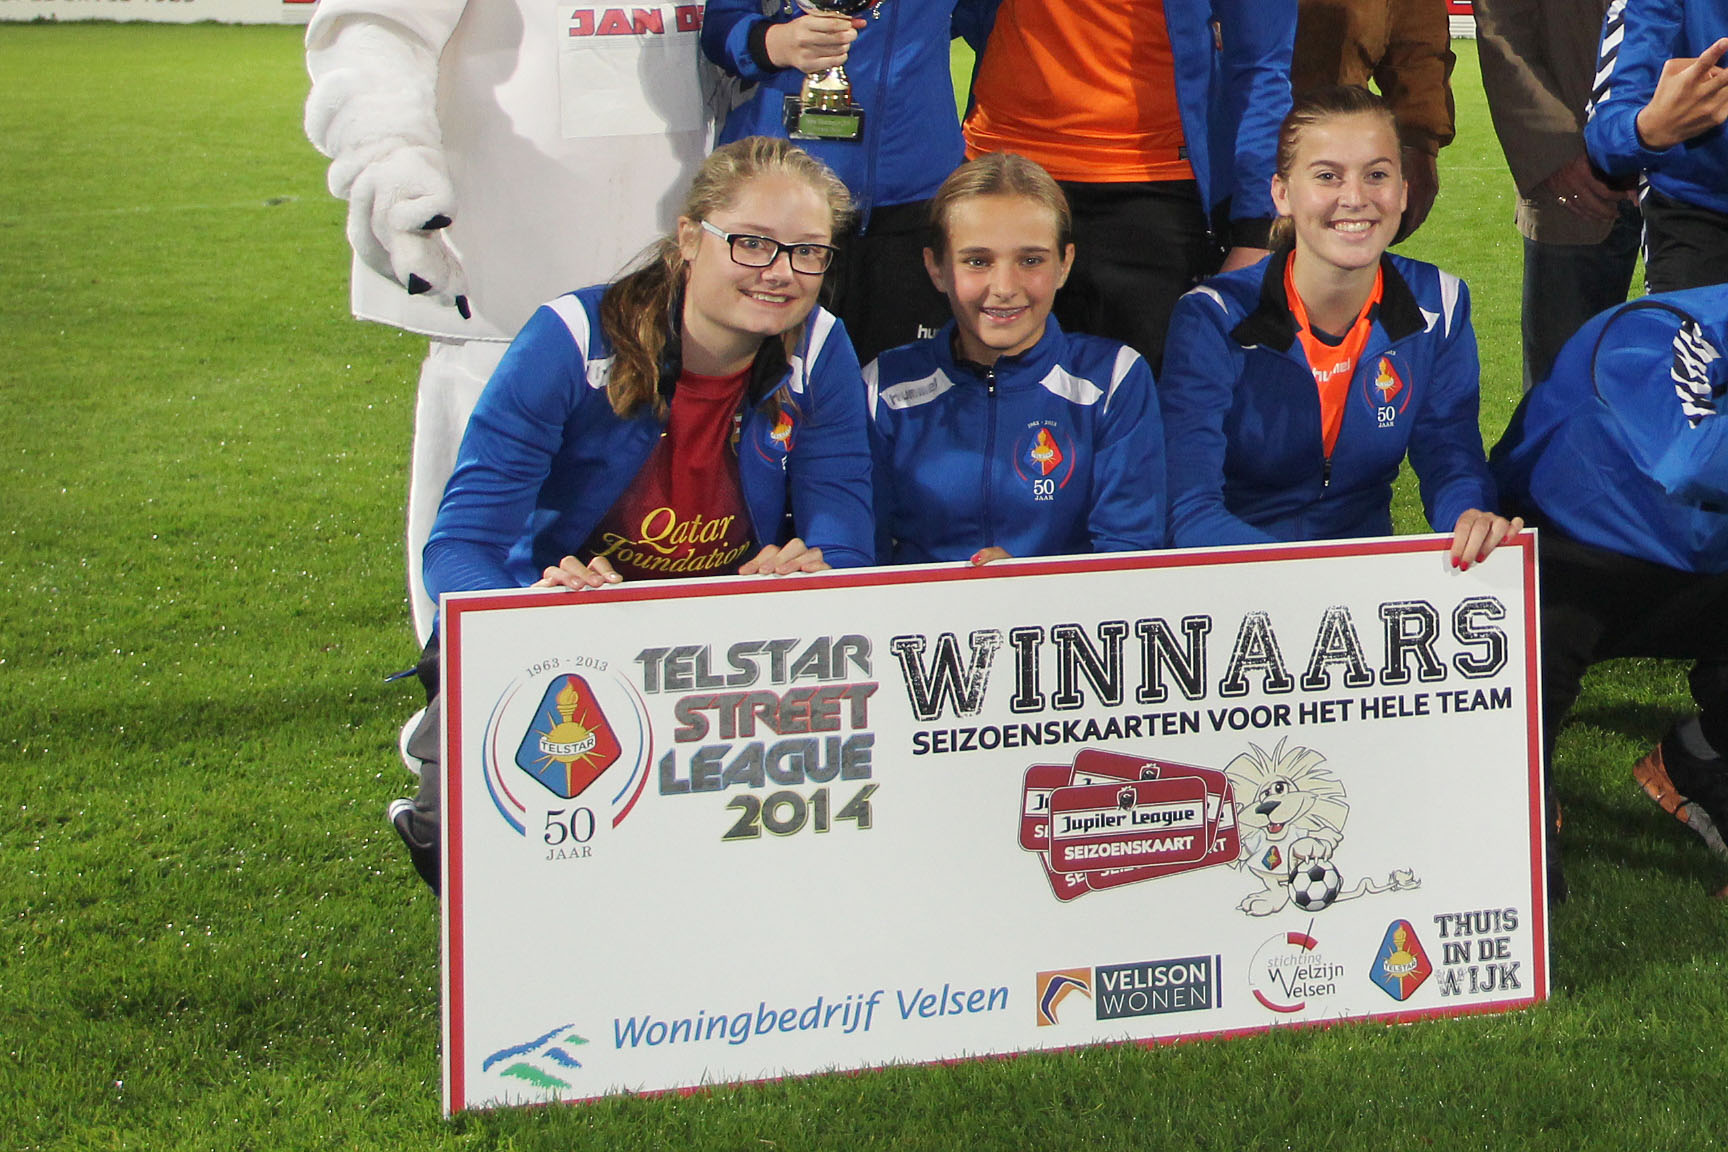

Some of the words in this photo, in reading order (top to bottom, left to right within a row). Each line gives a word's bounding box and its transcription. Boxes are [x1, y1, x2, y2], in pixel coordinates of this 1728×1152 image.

[569, 8, 665, 37] JAN
[1377, 405, 1396, 423] 50
[1033, 478, 1055, 495] 50
[638, 507, 736, 554] Qatar
[591, 532, 751, 573] Foundation
[525, 657, 561, 678] 1963
[575, 655, 610, 674] 2013
[634, 634, 873, 694] TELSTAR
[891, 595, 1510, 722] WINNAARS
[674, 681, 879, 744] STREET
[912, 711, 1201, 756] SEIZOENSKAARTEN
[1207, 705, 1292, 732] VOOR
[1299, 698, 1354, 726] HET
[1360, 693, 1430, 720] HELE
[1436, 687, 1513, 714] TEAM
[540, 736, 596, 756] TELSTAR
[658, 731, 876, 796] LEAGUE
[543, 806, 597, 847] 50
[721, 782, 880, 842] 2014
[1060, 812, 1128, 834] Jupiler
[1131, 808, 1195, 830] League
[545, 845, 593, 862] JAAR
[1063, 835, 1195, 862] SEIZOENSKAART
[1433, 908, 1519, 938] THUIS
[1267, 951, 1322, 969] stichting
[1442, 940, 1473, 966] IN
[1477, 936, 1512, 962] DE
[1101, 962, 1207, 993] VELISON
[1268, 963, 1344, 984] Welzijn
[1281, 978, 1337, 998] Velsen
[1435, 961, 1522, 997] WIJK
[1101, 984, 1207, 1015] WONEN
[613, 990, 884, 1050] Woningbedrijf
[896, 983, 1010, 1021] Velsen
